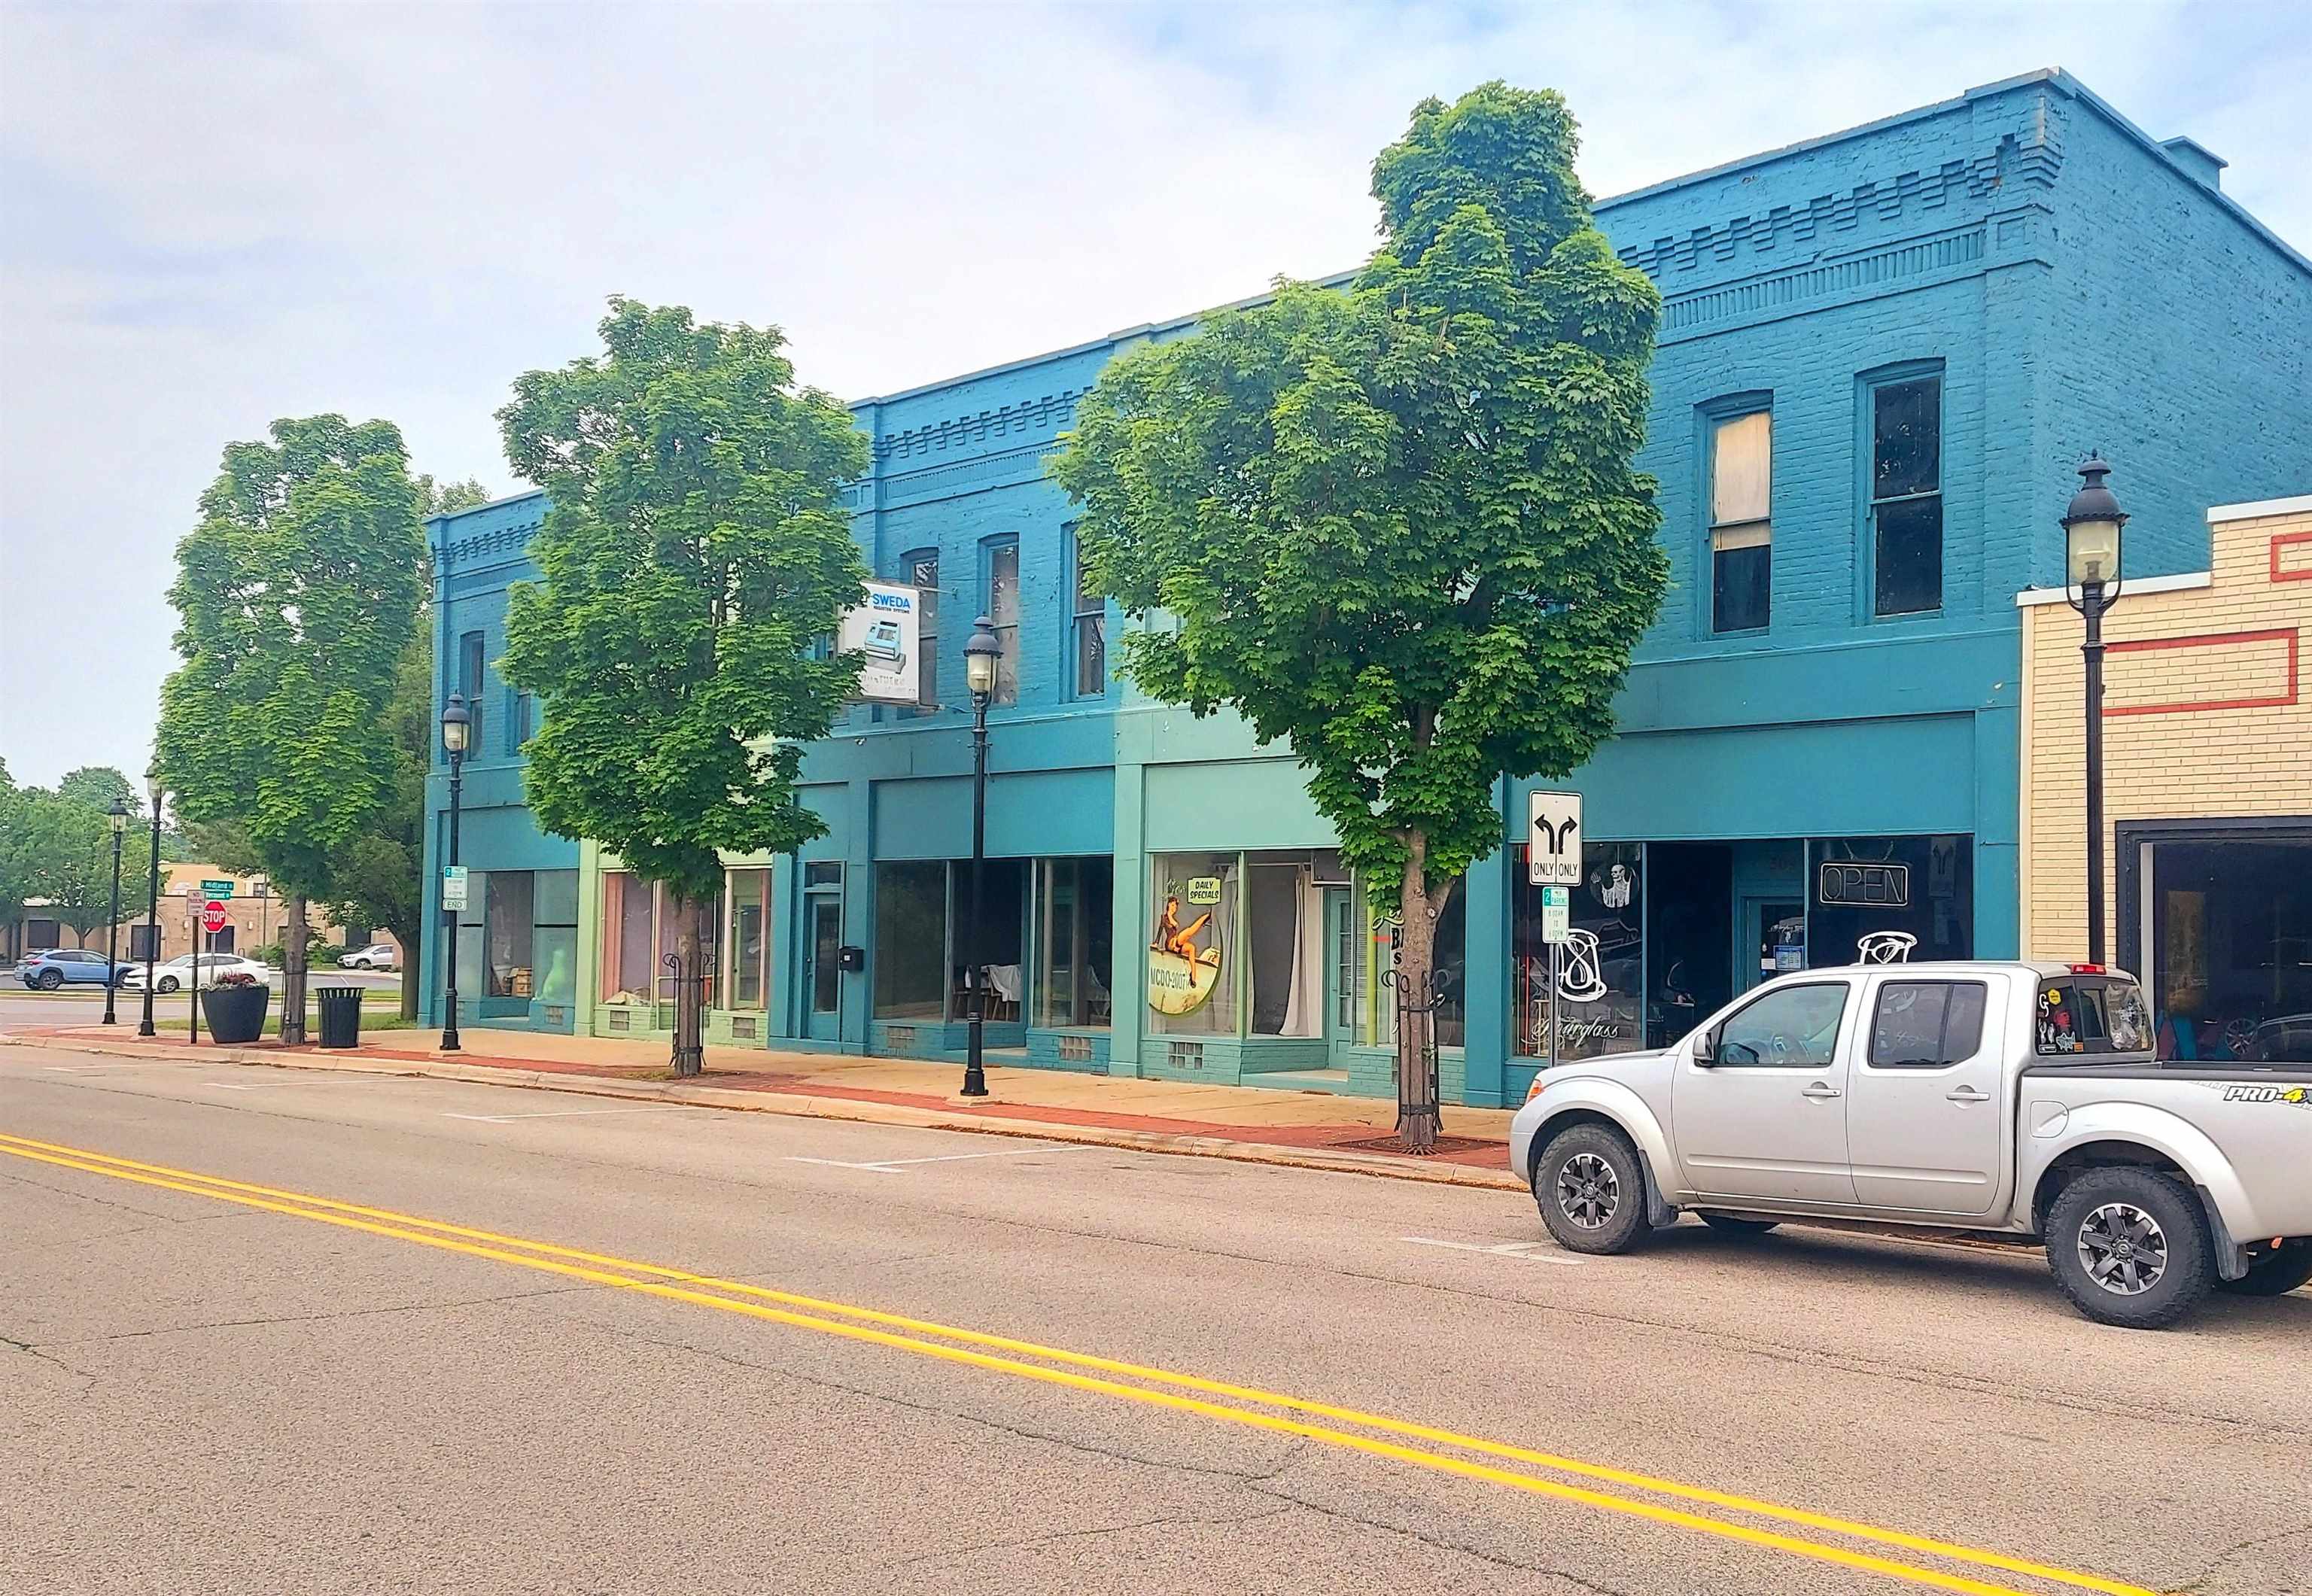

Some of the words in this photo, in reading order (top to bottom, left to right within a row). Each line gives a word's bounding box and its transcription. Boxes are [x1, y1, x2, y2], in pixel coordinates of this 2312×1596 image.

[873, 594, 910, 609] SWEDA
[1534, 862, 1554, 876] ONLY
[1559, 863, 1578, 877] ONLY
[1195, 881, 1214, 889] DAILY
[1824, 868, 1904, 902] OPEN
[1190, 891, 1219, 899] SPECIALS
[1545, 892, 1550, 902] 2
[203, 910, 225, 923] STOP
[2222, 1085, 2312, 1105] PRO-4
